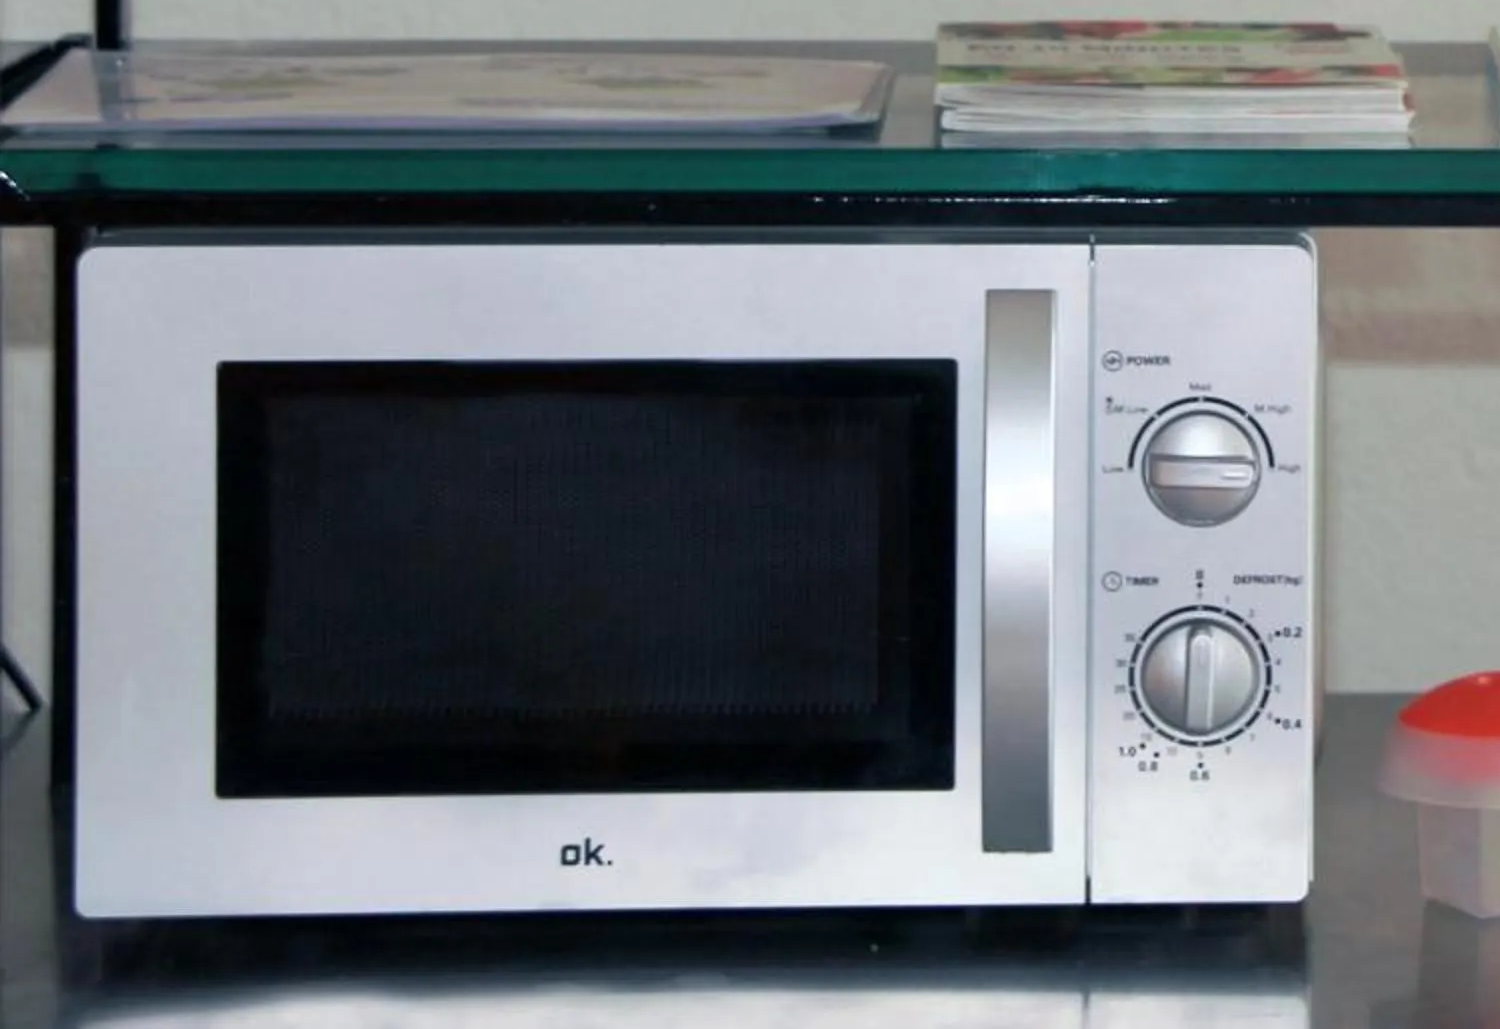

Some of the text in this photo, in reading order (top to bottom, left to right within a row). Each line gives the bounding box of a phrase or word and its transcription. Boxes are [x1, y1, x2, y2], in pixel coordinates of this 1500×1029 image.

[1126, 355, 1171, 367] POWER
[1125, 575, 1160, 586] TIMER
[1283, 627, 1303, 638] 0.2
[1281, 718, 1302, 730] 0.4
[1118, 746, 1137, 758] 1.0
[560, 836, 614, 866] ok.
